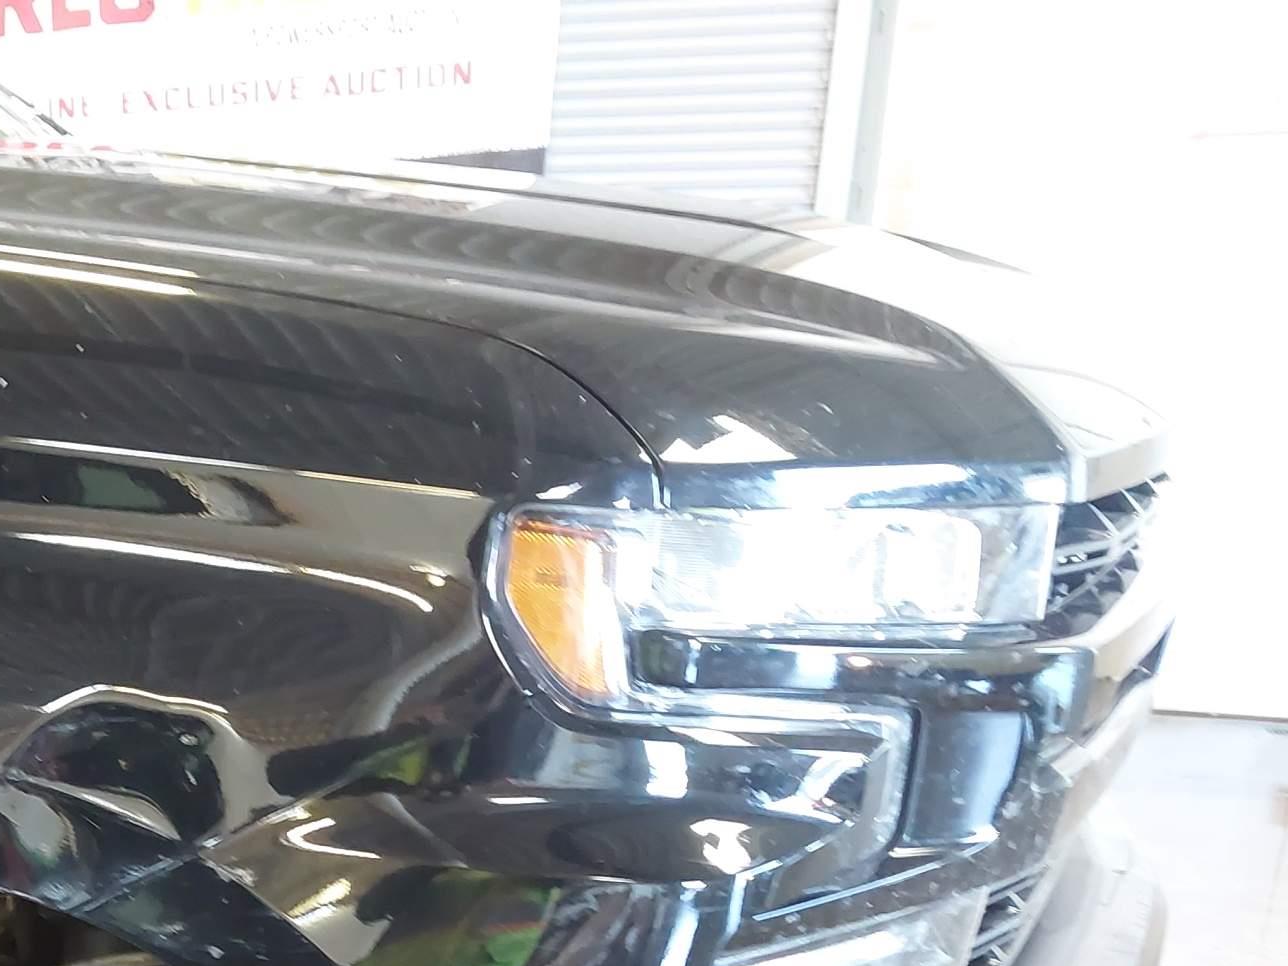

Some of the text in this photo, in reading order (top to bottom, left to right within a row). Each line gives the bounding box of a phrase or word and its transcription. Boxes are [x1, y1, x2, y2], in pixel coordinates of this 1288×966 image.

[47, 60, 472, 118] INE EXCLUSIVE AUCTION
